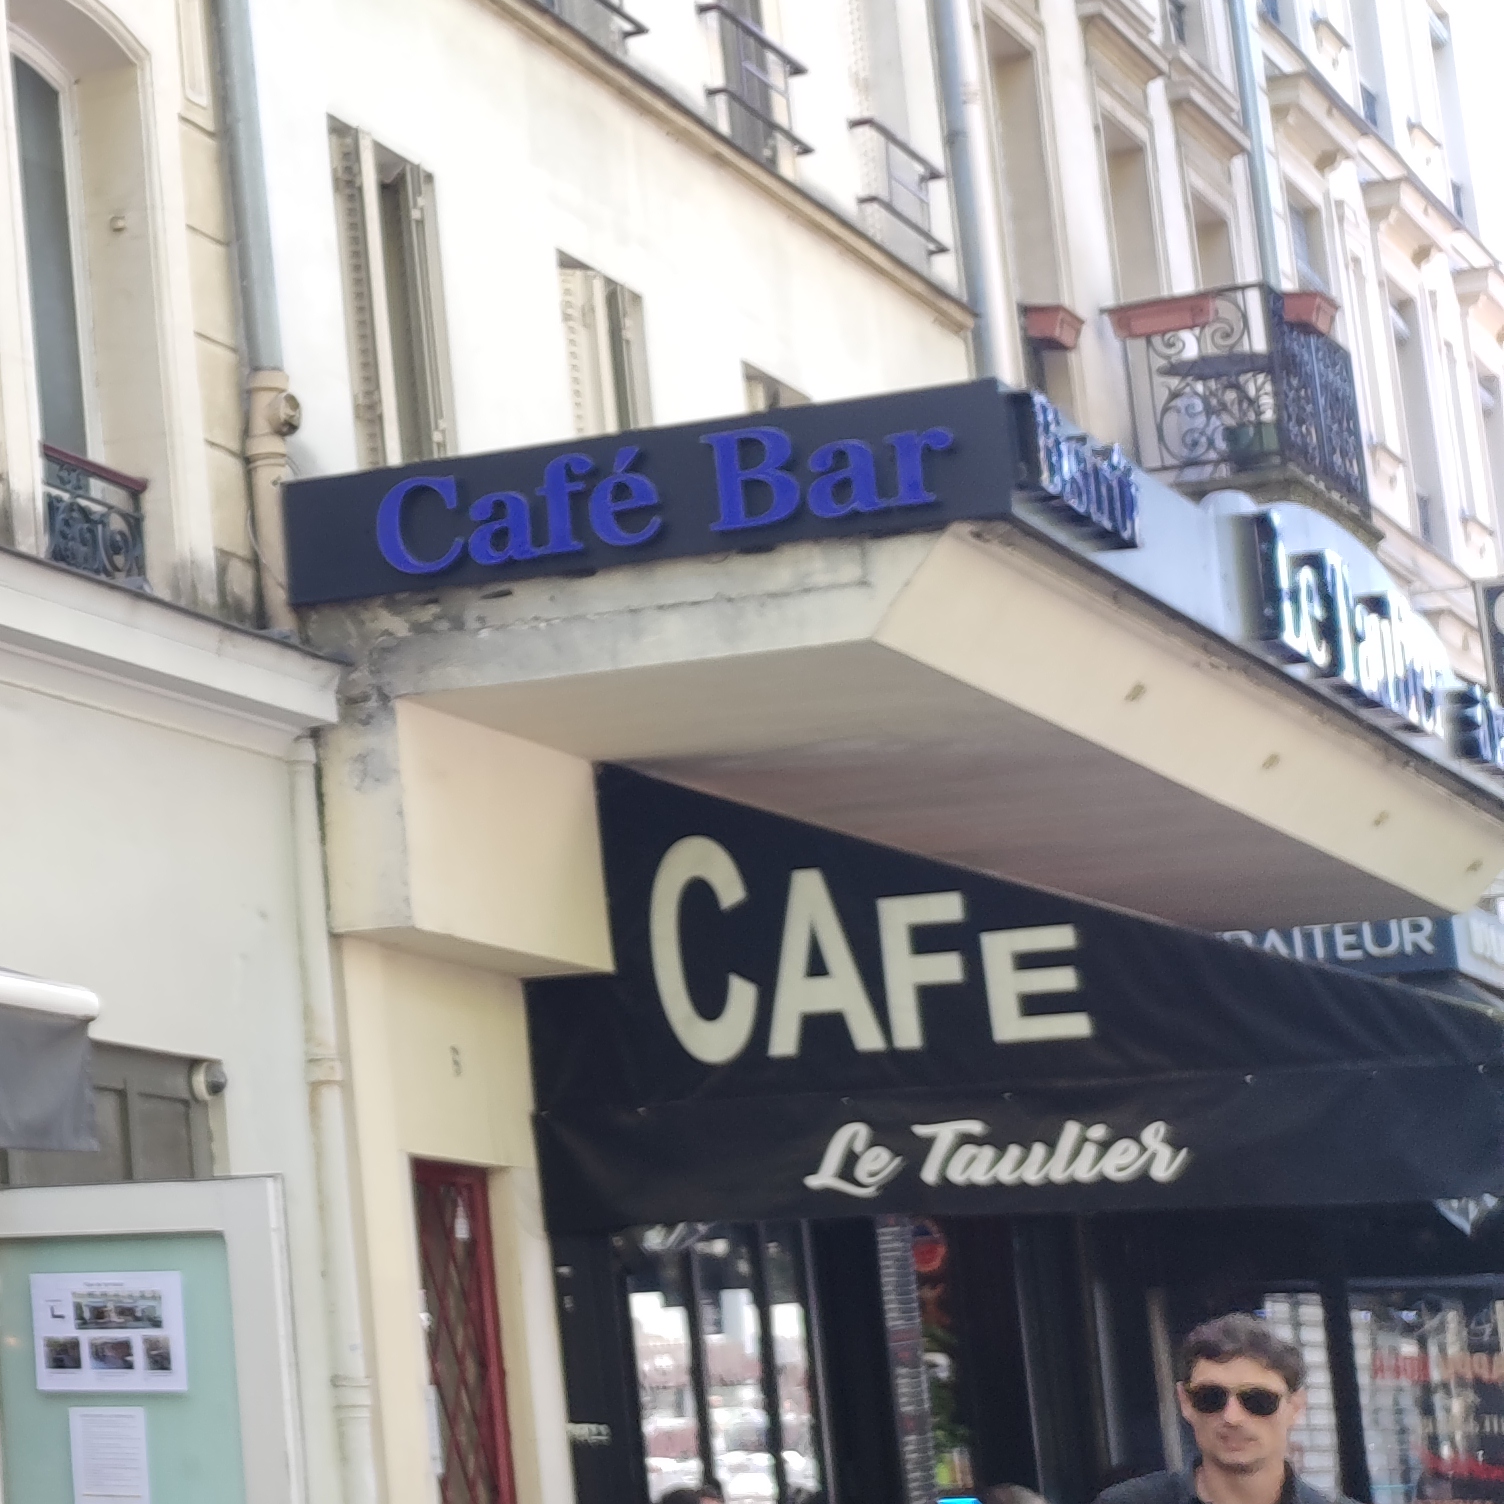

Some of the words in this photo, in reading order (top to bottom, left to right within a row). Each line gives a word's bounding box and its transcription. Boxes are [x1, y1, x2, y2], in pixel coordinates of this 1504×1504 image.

[374, 445, 664, 577] Café
[703, 421, 955, 533] Bar
[649, 835, 1094, 1066] CAFE
[1215, 916, 1436, 961] AITEUR
[803, 1120, 903, 1197] Le
[910, 1118, 1193, 1187] Taulier
